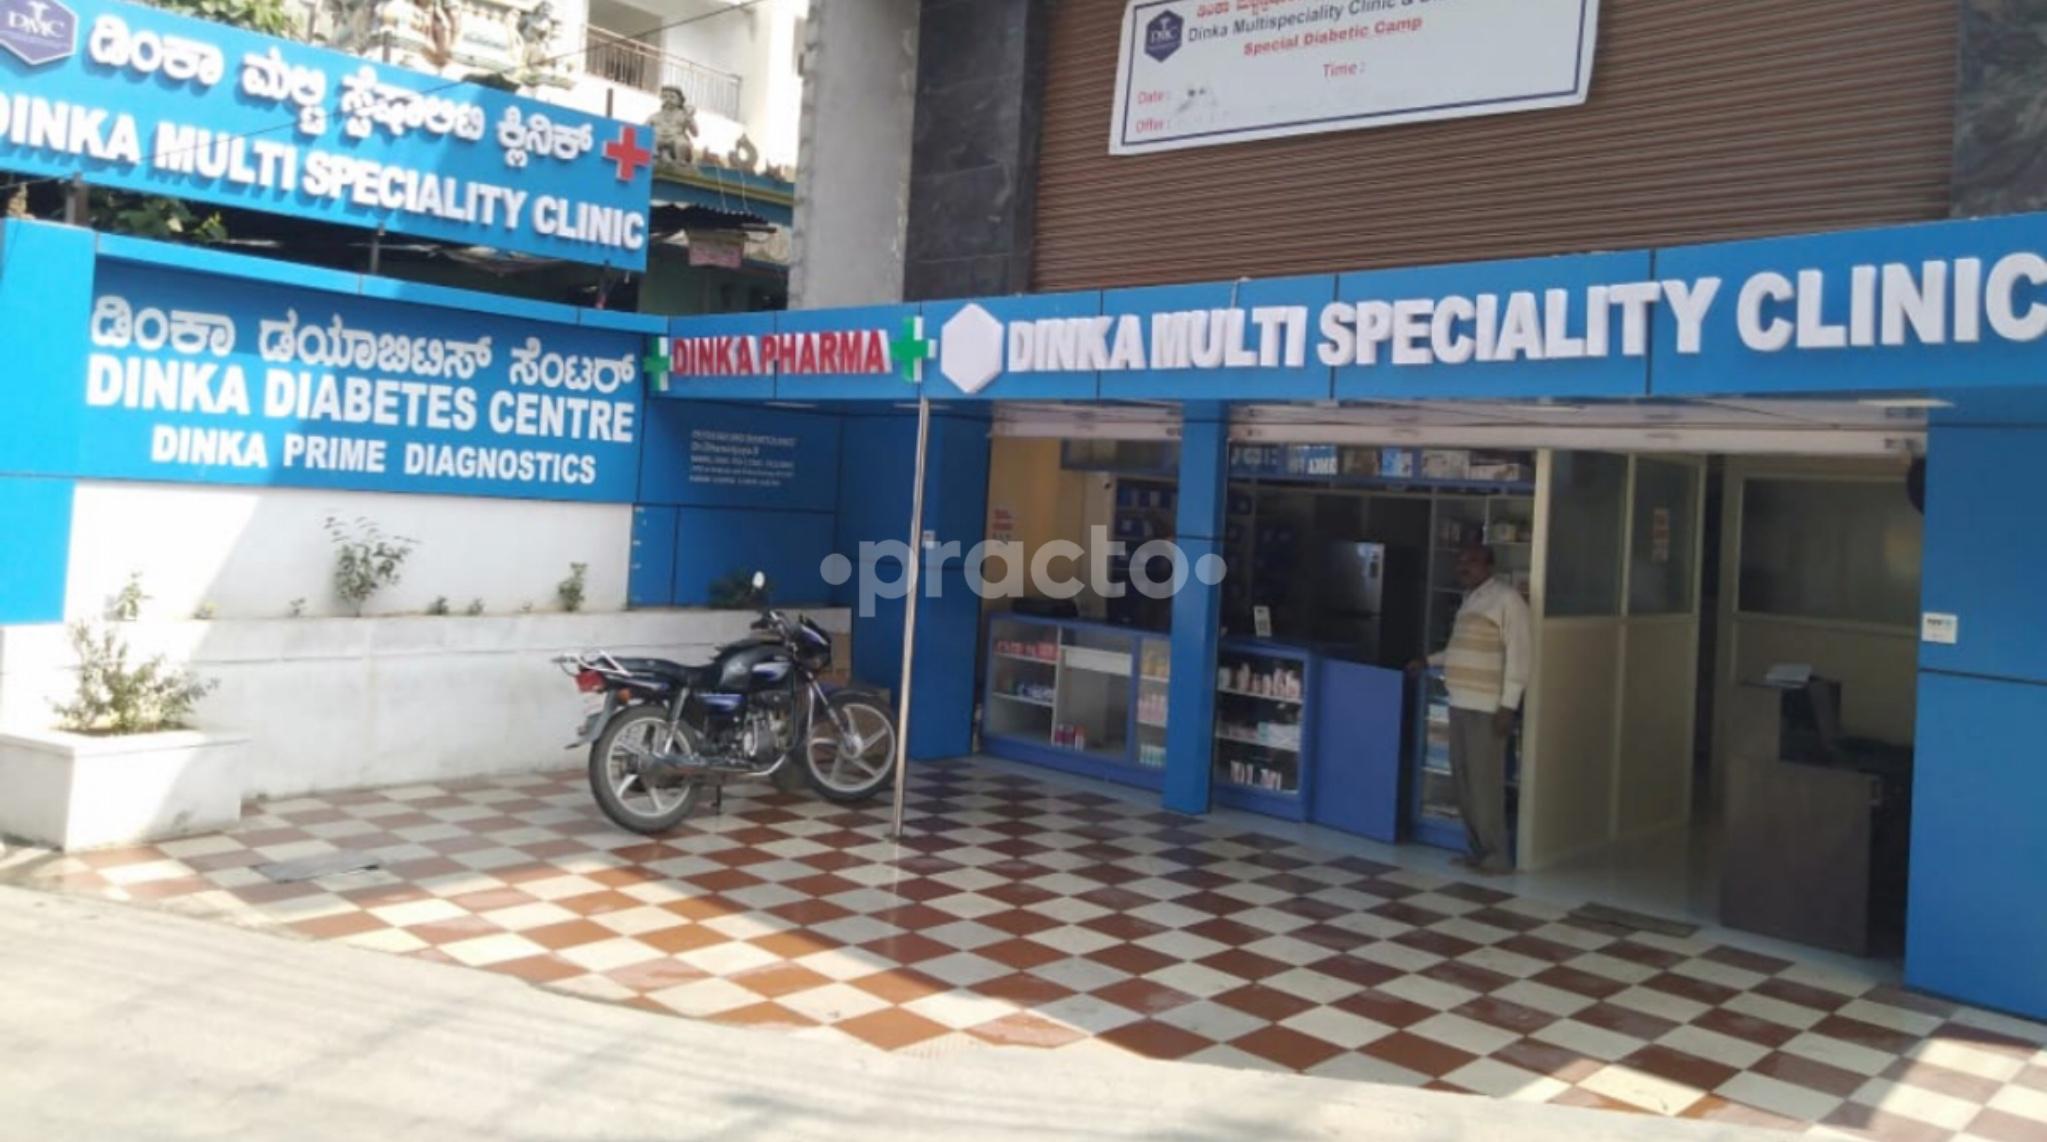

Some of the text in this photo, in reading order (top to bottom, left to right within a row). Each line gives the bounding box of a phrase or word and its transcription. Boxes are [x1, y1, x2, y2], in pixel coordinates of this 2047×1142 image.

[8, 10, 65, 38] DMC
[1188, 26, 1228, 42] Dinka
[1233, 3, 1345, 34] Multispeciality
[1348, 0, 1397, 16] Clinic
[1243, 16, 1423, 56] Special Diabetic Camp
[90, 14, 224, 86] ಡಿಂಕಾ
[496, 105, 593, 168] ಕ್ಲಿನಿಕ್
[154, 119, 298, 191] MULTI
[304, 152, 528, 230] SPECIALITY
[533, 194, 645, 250] CLINIC
[90, 296, 636, 394] ಡಿಂಕಾ ಡಯಾಬಿಟಿಸ್ ಸೆಂಟರ್
[1007, 251, 2047, 373] DINKA MULTI SPECIALITY CLINIC
[672, 329, 892, 377] DINKA PHARMA
[86, 355, 634, 443] DINKA DIABETES CENTRE
[150, 424, 597, 485] DINKA PRIME DIAGNOSTICS
